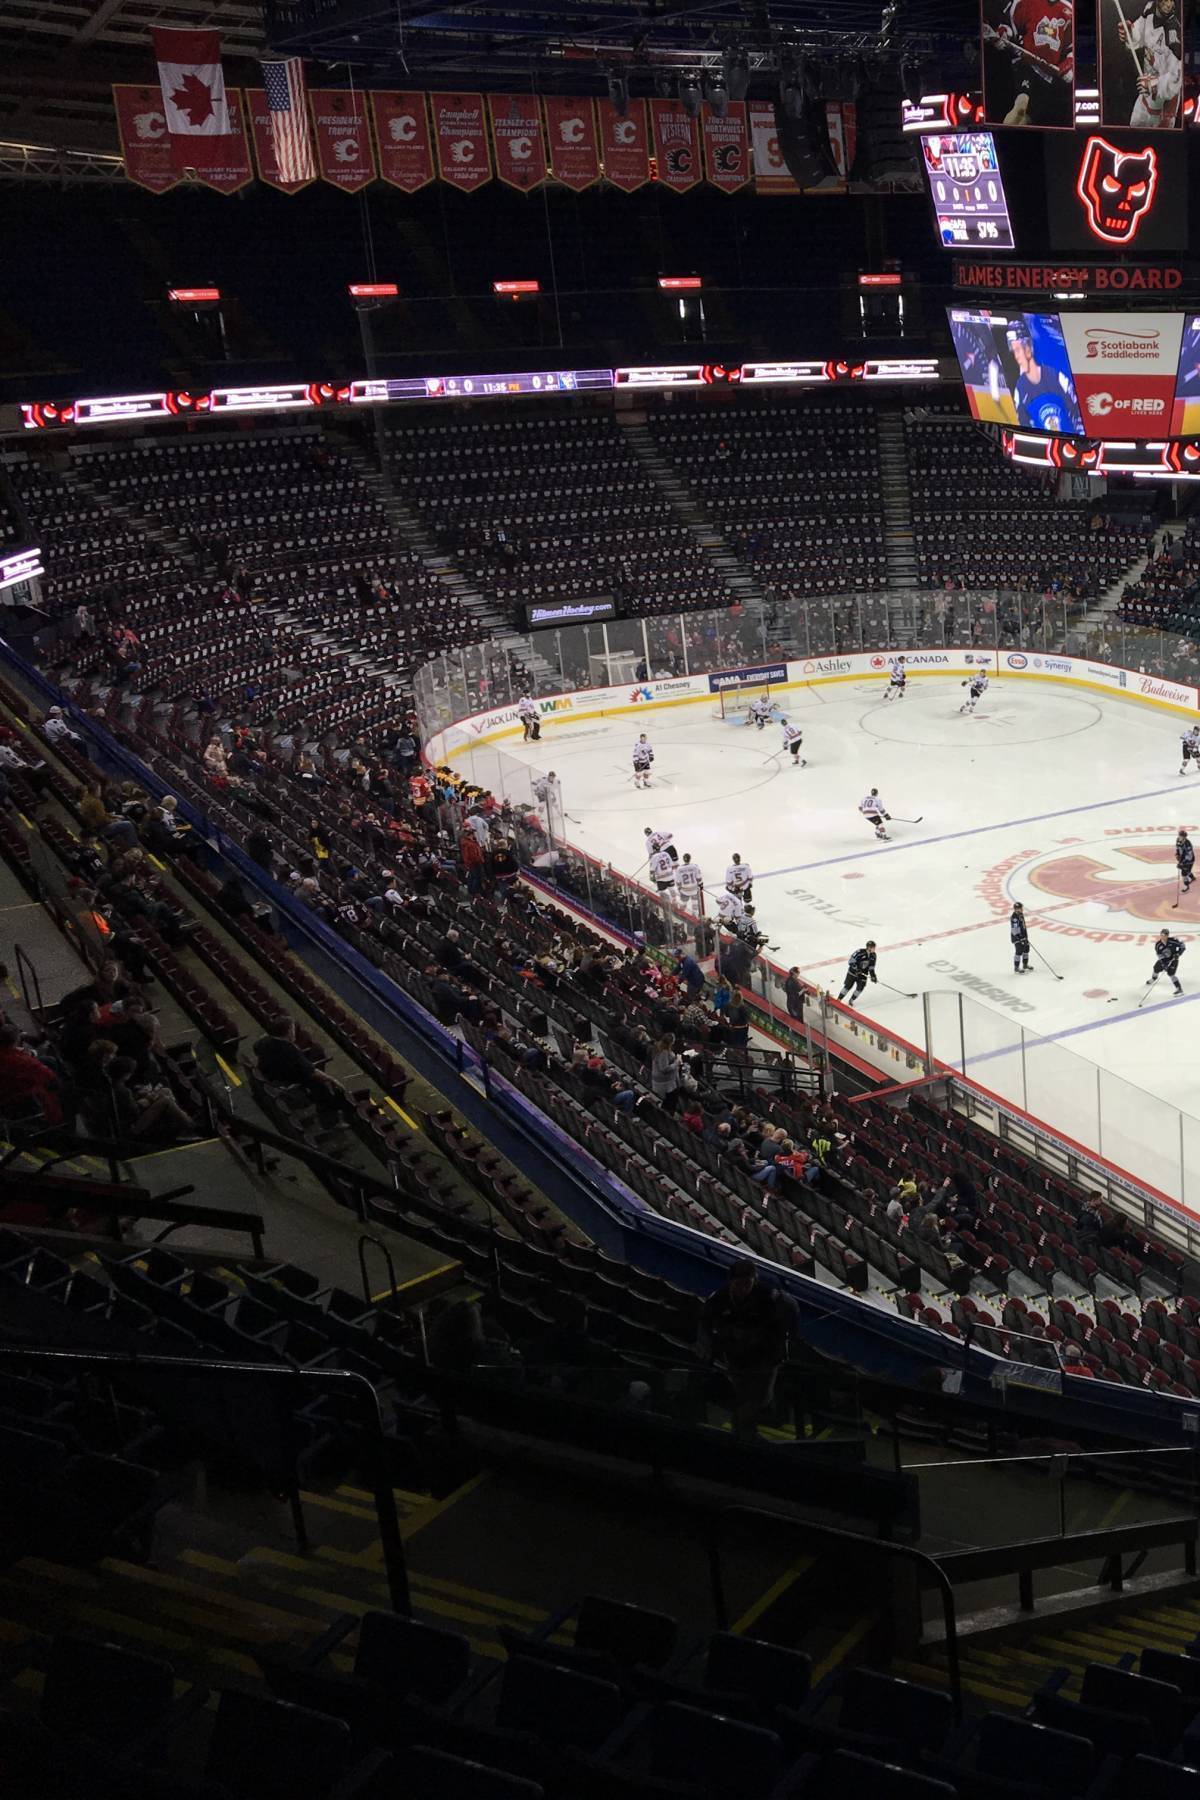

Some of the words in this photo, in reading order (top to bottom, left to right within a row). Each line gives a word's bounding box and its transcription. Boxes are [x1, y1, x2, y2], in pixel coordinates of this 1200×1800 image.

[958, 266, 1002, 287] FLAMES
[1006, 267, 1089, 288] ENERGY
[1095, 268, 1182, 289] BOARD
[1100, 340, 1160, 350] Scotiabank
[1100, 350, 1160, 359] Saddledome
[1114, 399, 1131, 409] OF
[1131, 398, 1165, 411] RED
[530, 602, 613, 623] HitmenHockey.com
[815, 656, 853, 674] Ashley
[905, 655, 949, 664] CANADA
[1044, 661, 1073, 673] Synergy
[664, 681, 691, 692] Chesney
[1138, 676, 1190, 704] Budweiser
[540, 697, 574, 713] WM
[487, 713, 506, 728] JACK
[784, 888, 842, 917] TELUS
